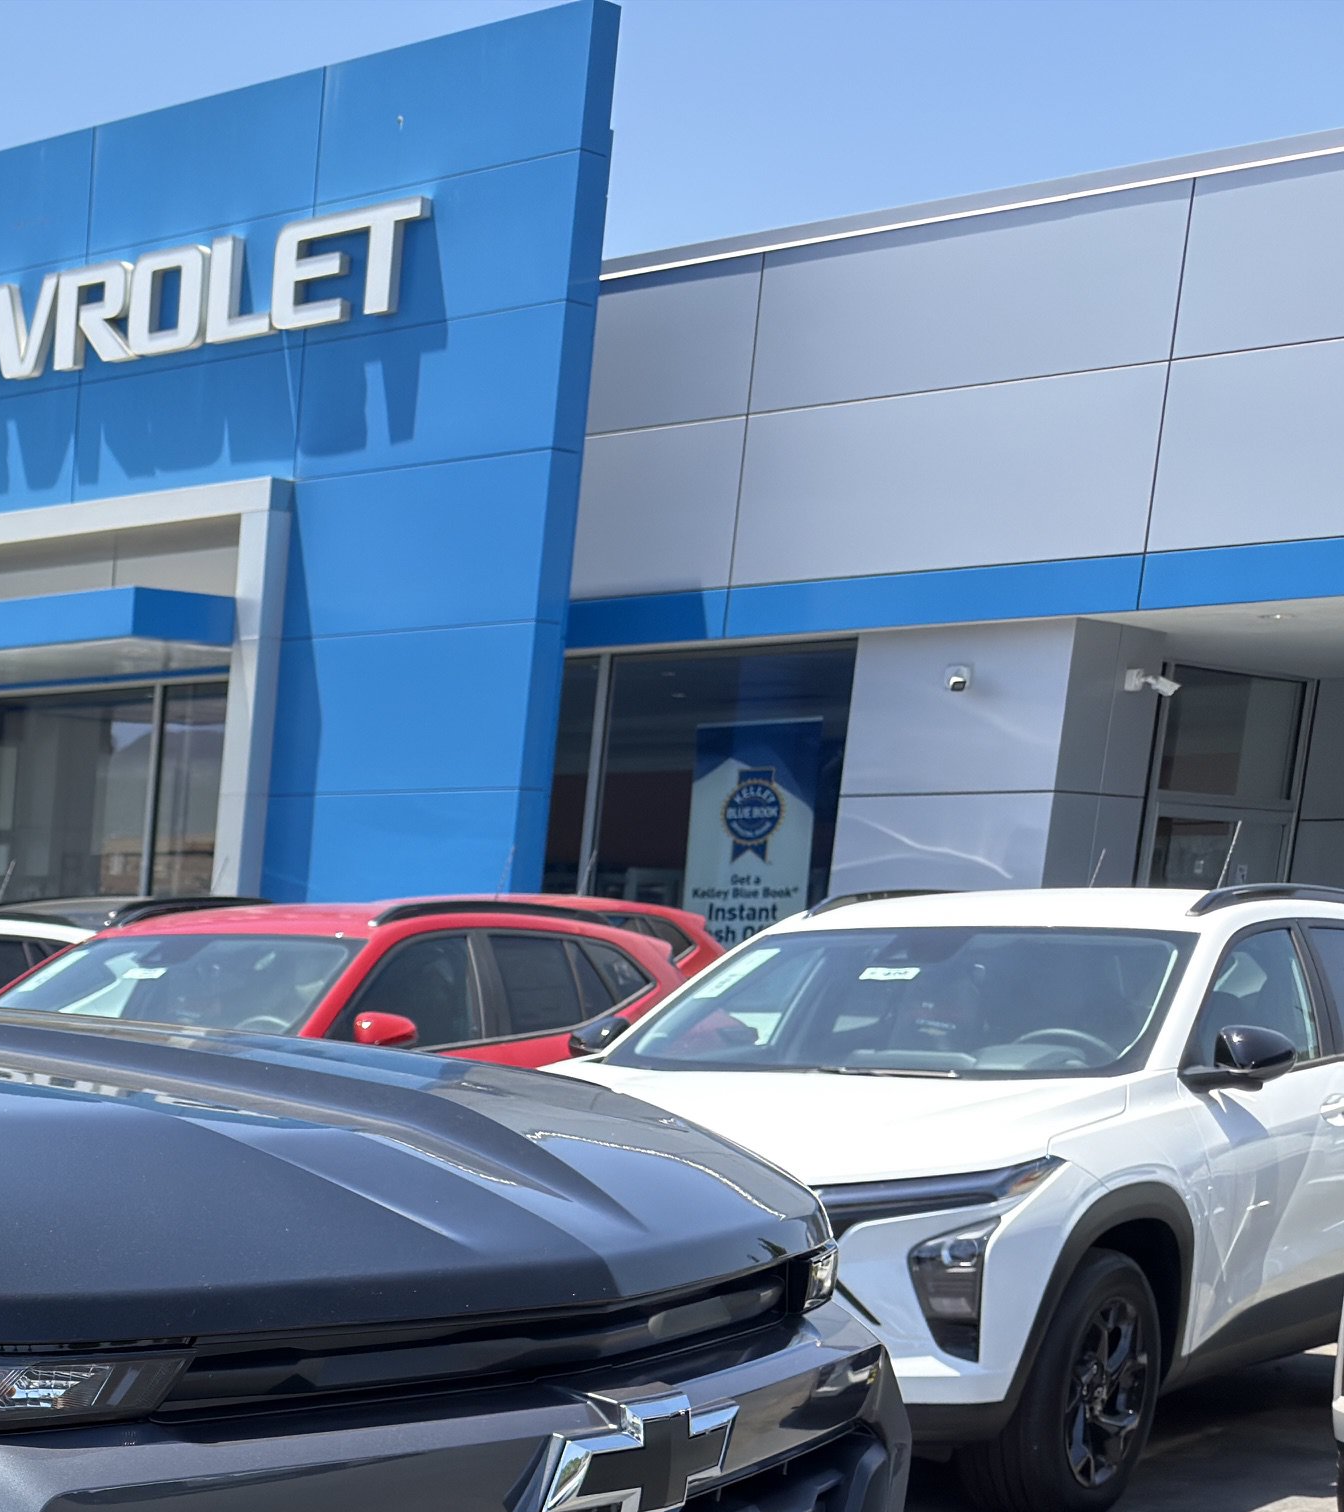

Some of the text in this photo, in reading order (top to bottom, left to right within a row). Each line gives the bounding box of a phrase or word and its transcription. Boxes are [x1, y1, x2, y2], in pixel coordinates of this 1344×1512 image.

[733, 786, 777, 804] KELLEY
[731, 874, 750, 885] Get
[693, 887, 729, 900] Kelley
[732, 887, 759, 898] Blue
[708, 903, 778, 920] Instant
